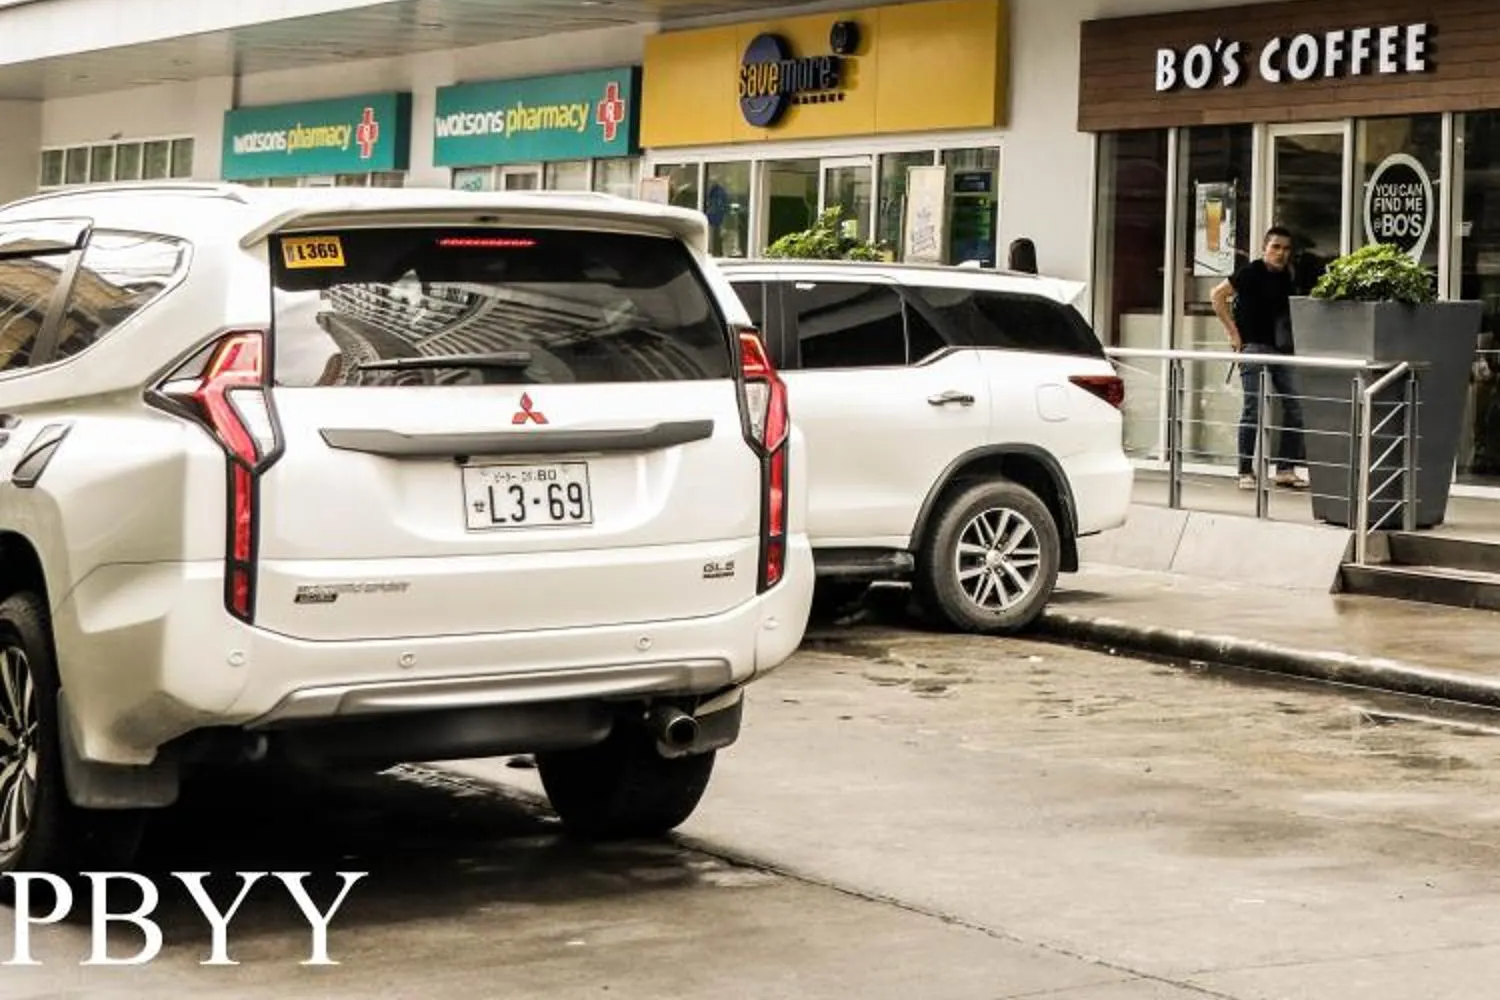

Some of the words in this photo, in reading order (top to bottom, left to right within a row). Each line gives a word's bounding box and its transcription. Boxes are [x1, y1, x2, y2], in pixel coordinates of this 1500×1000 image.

[1156, 37, 1240, 92] BO'S
[1259, 23, 1427, 83] COFFEE
[738, 56, 832, 97] savemore
[436, 109, 504, 137] watsons
[506, 101, 590, 138] pharmacy
[233, 130, 287, 155] watsons
[287, 121, 352, 155] pharmacy
[1374, 197, 1401, 213] FIND
[1405, 197, 1423, 212] ME
[1375, 183, 1397, 197] YOU
[1399, 183, 1423, 197] CAN
